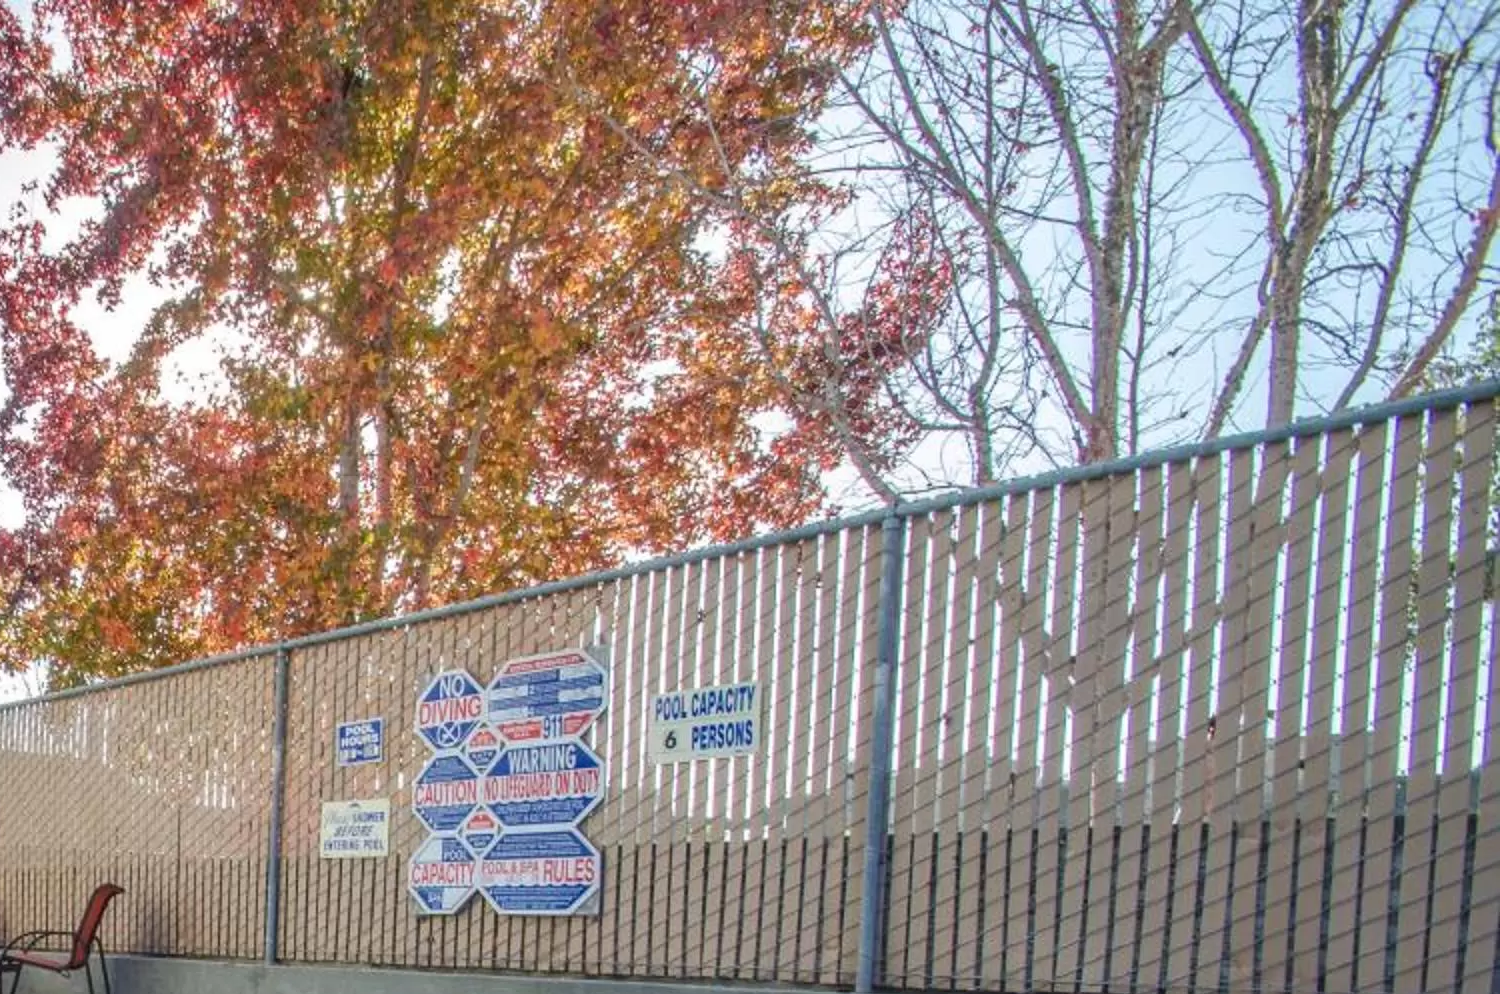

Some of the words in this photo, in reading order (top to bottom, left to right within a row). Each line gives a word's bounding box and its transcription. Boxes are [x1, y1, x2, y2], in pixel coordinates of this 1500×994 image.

[439, 675, 466, 698] NO
[419, 696, 482, 725] DIVING
[655, 694, 688, 721] POOL
[691, 685, 756, 717] CAPACITY
[345, 724, 375, 737] POOL
[543, 714, 564, 739] 911
[665, 730, 677, 749] 6
[691, 719, 753, 750] PERSONS
[508, 744, 577, 776] WARNING
[415, 780, 477, 806] CAUTION
[483, 780, 499, 801] NO
[500, 774, 550, 800] LIFEGUARD
[555, 772, 569, 795] ON
[573, 768, 599, 794] DUTY
[412, 863, 475, 884] CAPACITY
[482, 862, 509, 876] POOL
[543, 857, 595, 883] RULES
